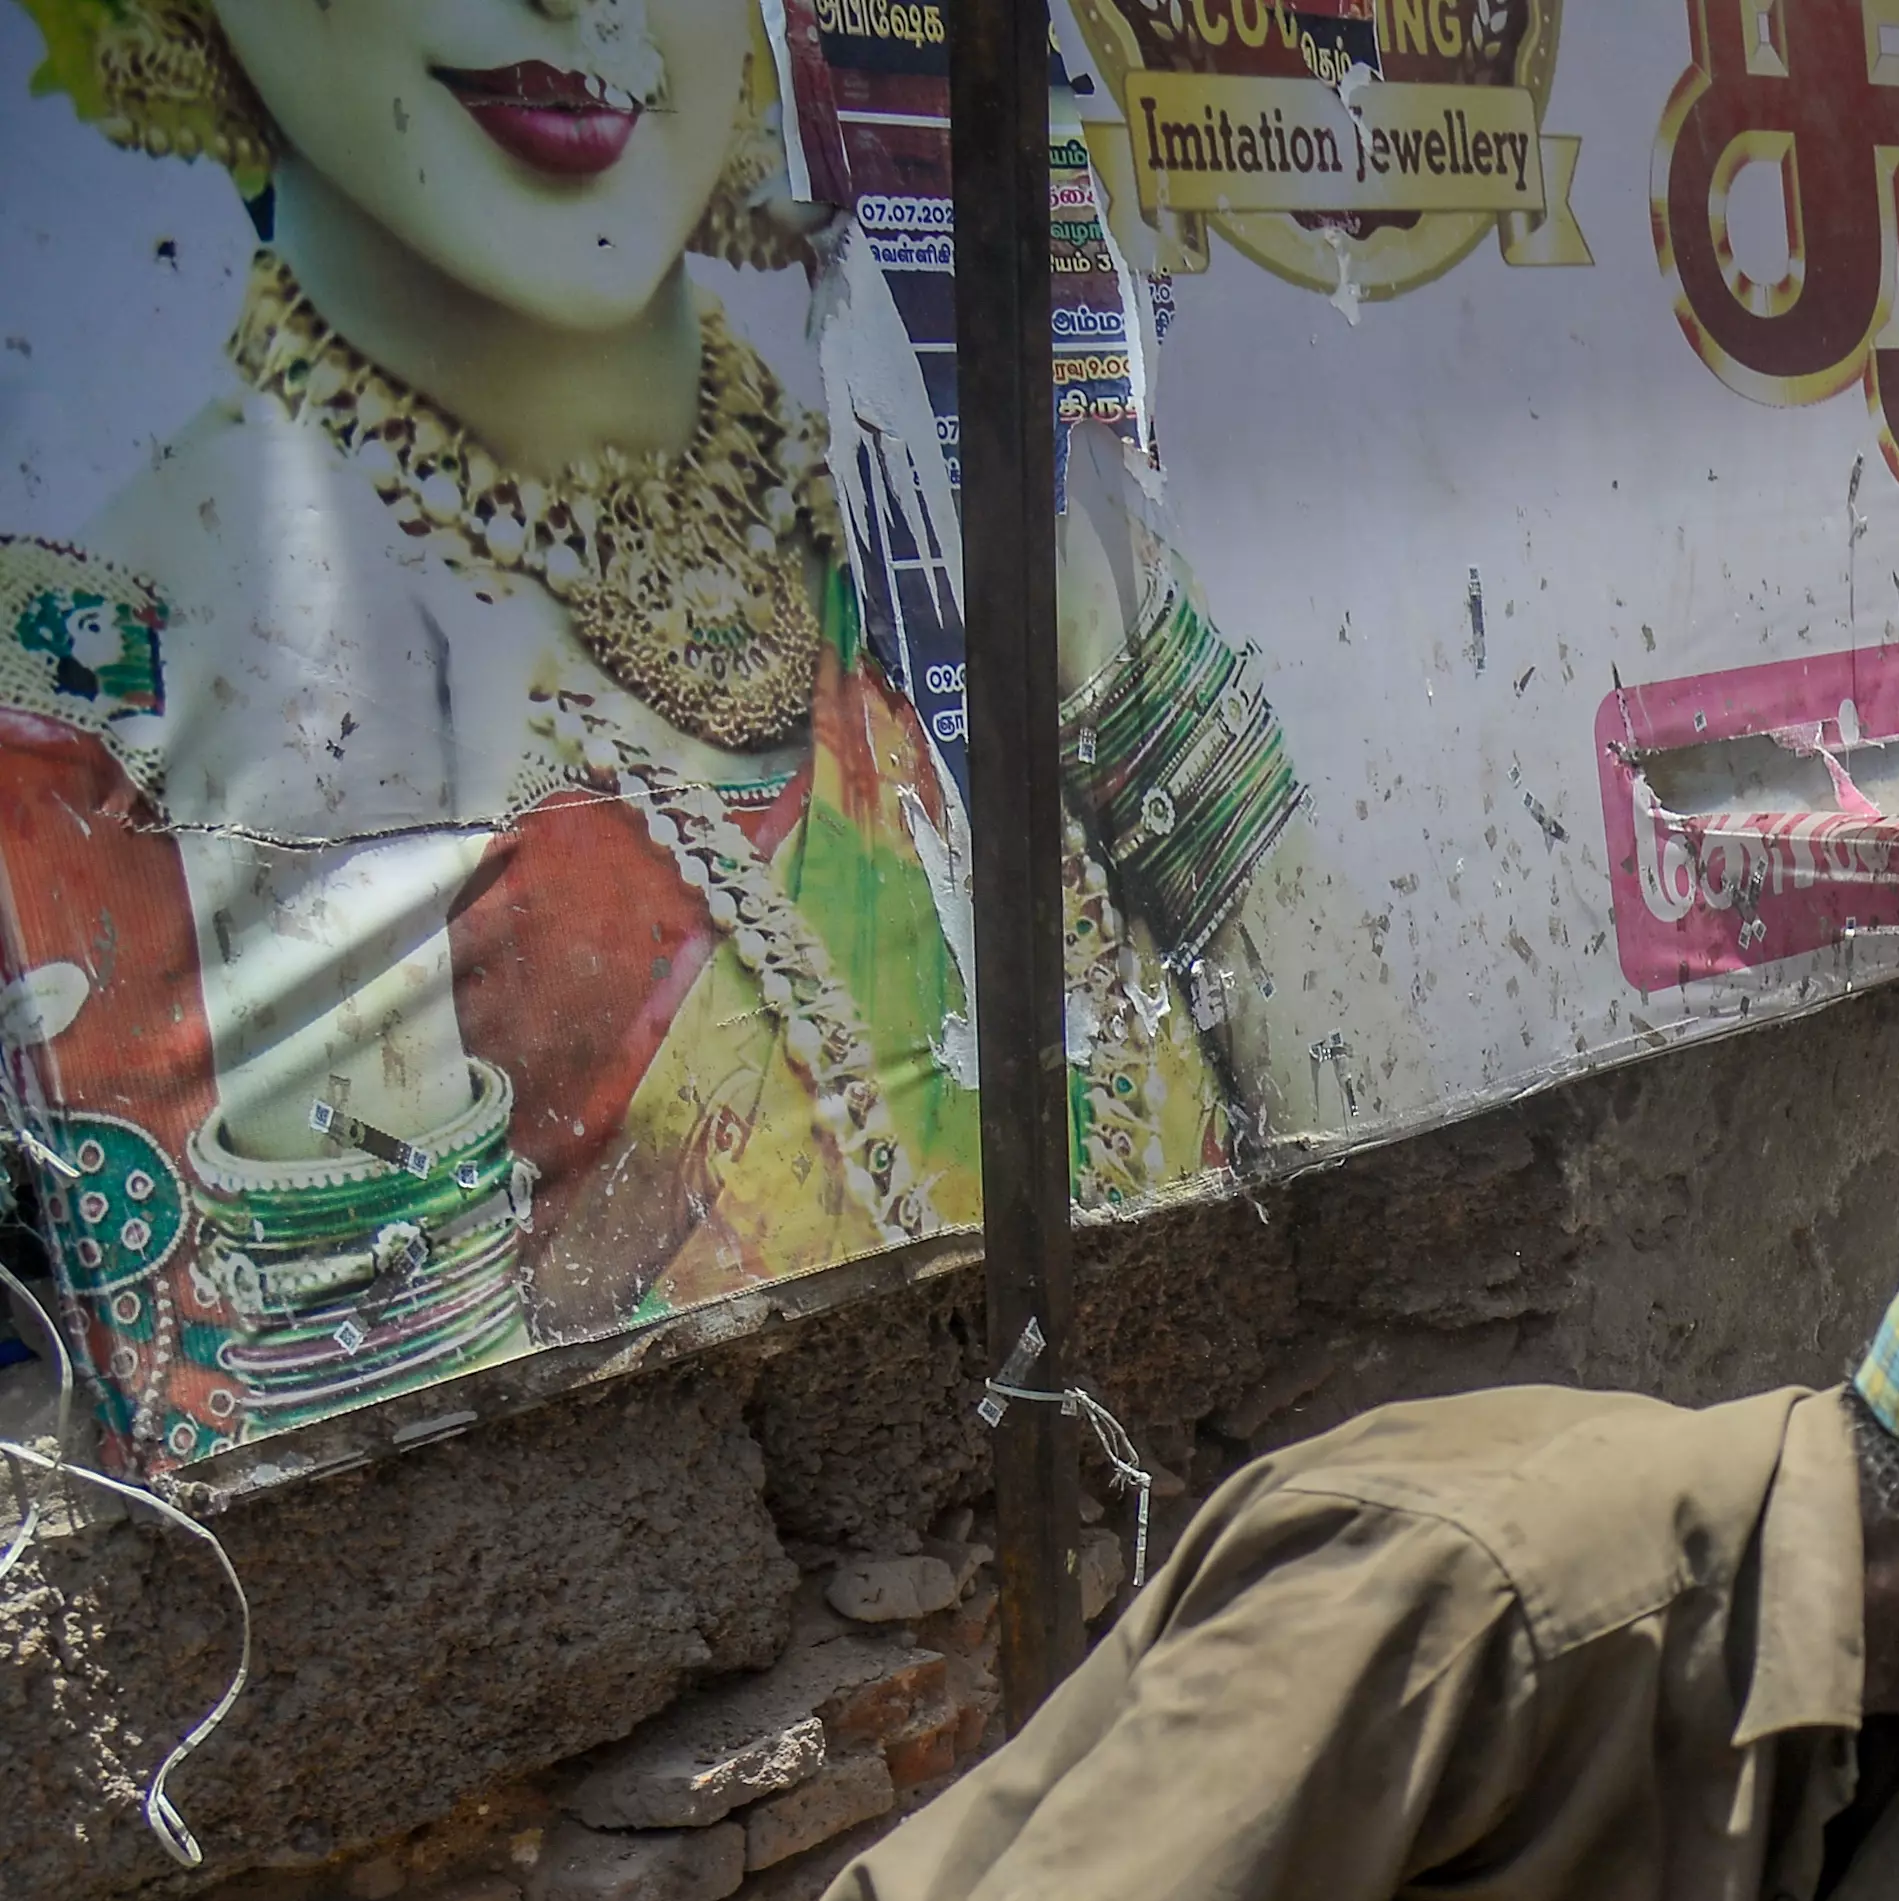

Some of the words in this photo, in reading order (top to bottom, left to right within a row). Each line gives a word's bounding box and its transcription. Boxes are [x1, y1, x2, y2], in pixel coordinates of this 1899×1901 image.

[1191, 0, 1463, 58] COVING
[1140, 97, 1343, 173] Imitation
[861, 202, 955, 225] 07.07.202
[1052, 307, 1125, 334] அம்ம
